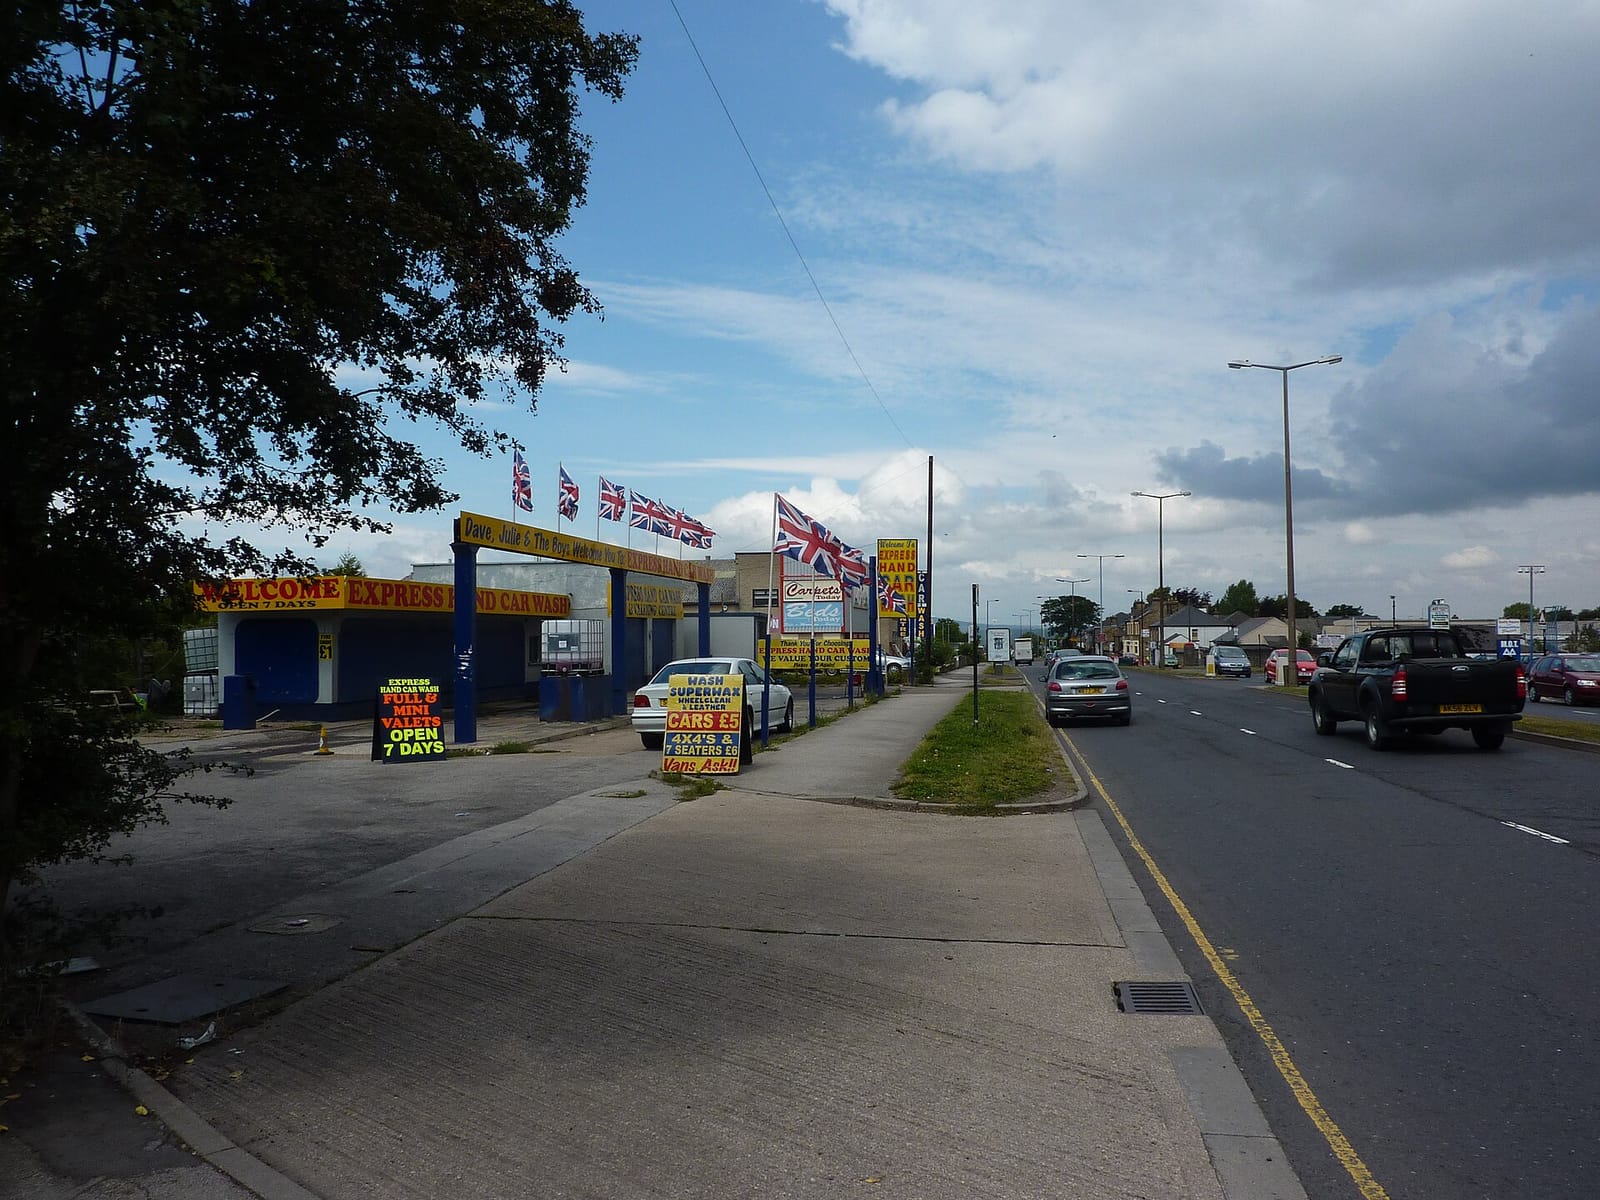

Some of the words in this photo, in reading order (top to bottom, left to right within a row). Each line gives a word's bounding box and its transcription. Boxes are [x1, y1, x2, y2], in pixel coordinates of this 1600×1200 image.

[464, 517, 495, 543] Dave,
[498, 525, 521, 546] Julie
[523, 530, 531, 547] &
[534, 532, 550, 551] The
[552, 536, 570, 557] Boys
[573, 541, 602, 561] Welcome
[880, 540, 904, 549] Welcome
[879, 549, 916, 561] EXPRESS
[880, 562, 916, 573] HAND
[201, 578, 340, 601] WELCOME
[786, 582, 841, 597] Carpets
[918, 573, 926, 604] CAR
[348, 579, 444, 608] EXPRESS
[448, 587, 497, 611] HND
[500, 592, 530, 612] CAR
[533, 594, 569, 614] WASH
[218, 601, 259, 610] OPEN
[264, 601, 272, 609] 7
[275, 600, 317, 609] DAYS
[785, 602, 840, 618] Beds
[917, 607, 926, 638] WASH
[687, 676, 724, 686] WASH
[383, 693, 423, 704] FULL
[425, 692, 438, 703] &
[669, 687, 740, 697] SUPERWAX
[393, 705, 430, 716] MINI
[381, 717, 441, 729] VALETS
[667, 712, 714, 729] CARS
[719, 713, 739, 729] £5
[390, 727, 438, 742] OPEN
[671, 734, 716, 745] 4X4'S
[721, 734, 733, 745] &
[383, 743, 394, 757] 7
[400, 741, 444, 756] DAYS
[665, 745, 673, 755] 7
[674, 745, 722, 755] SEATERS
[725, 745, 738, 756] £6
[663, 757, 697, 772] Vans
[701, 758, 738, 772] Ask!!
